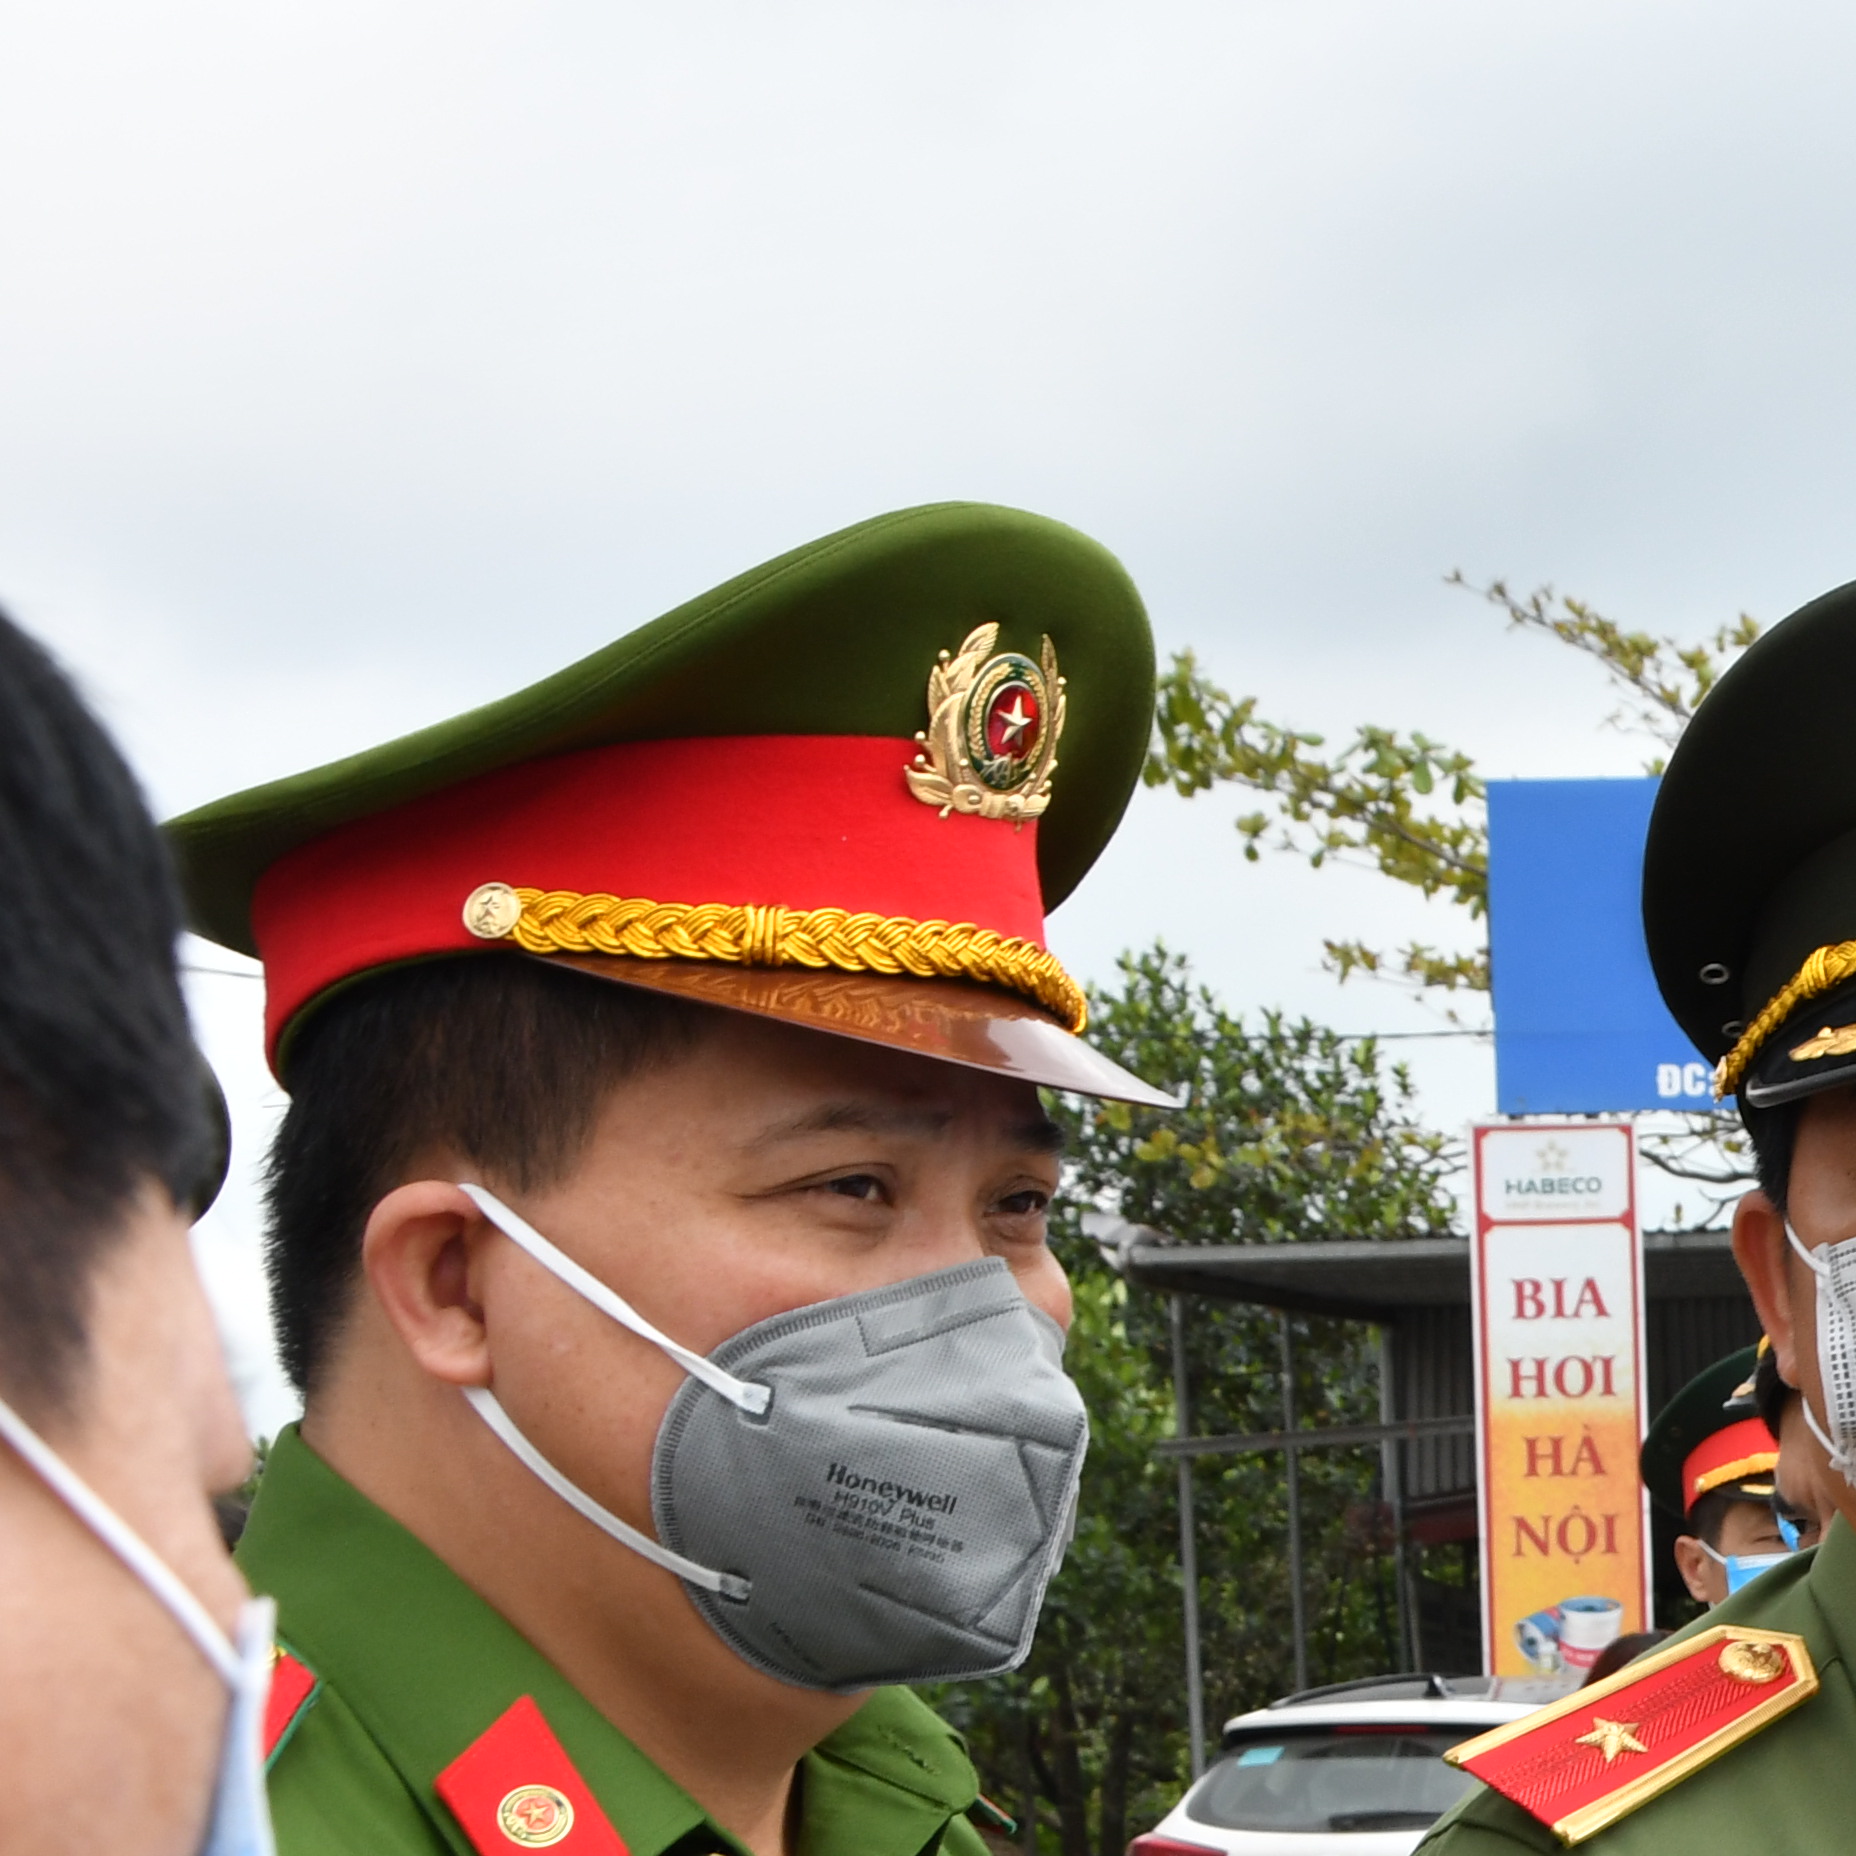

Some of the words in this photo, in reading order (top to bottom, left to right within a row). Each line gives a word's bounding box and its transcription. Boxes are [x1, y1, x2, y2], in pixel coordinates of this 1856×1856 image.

[1505, 1176, 1602, 1195] HABECO
[1511, 1277, 1610, 1319] BIA
[1507, 1354, 1616, 1399] HƠI
[1522, 1424, 1606, 1477] HÀ
[826, 1462, 957, 1516] Honeywell
[899, 1507, 936, 1531] Plus
[1511, 1504, 1619, 1564] NỘI
